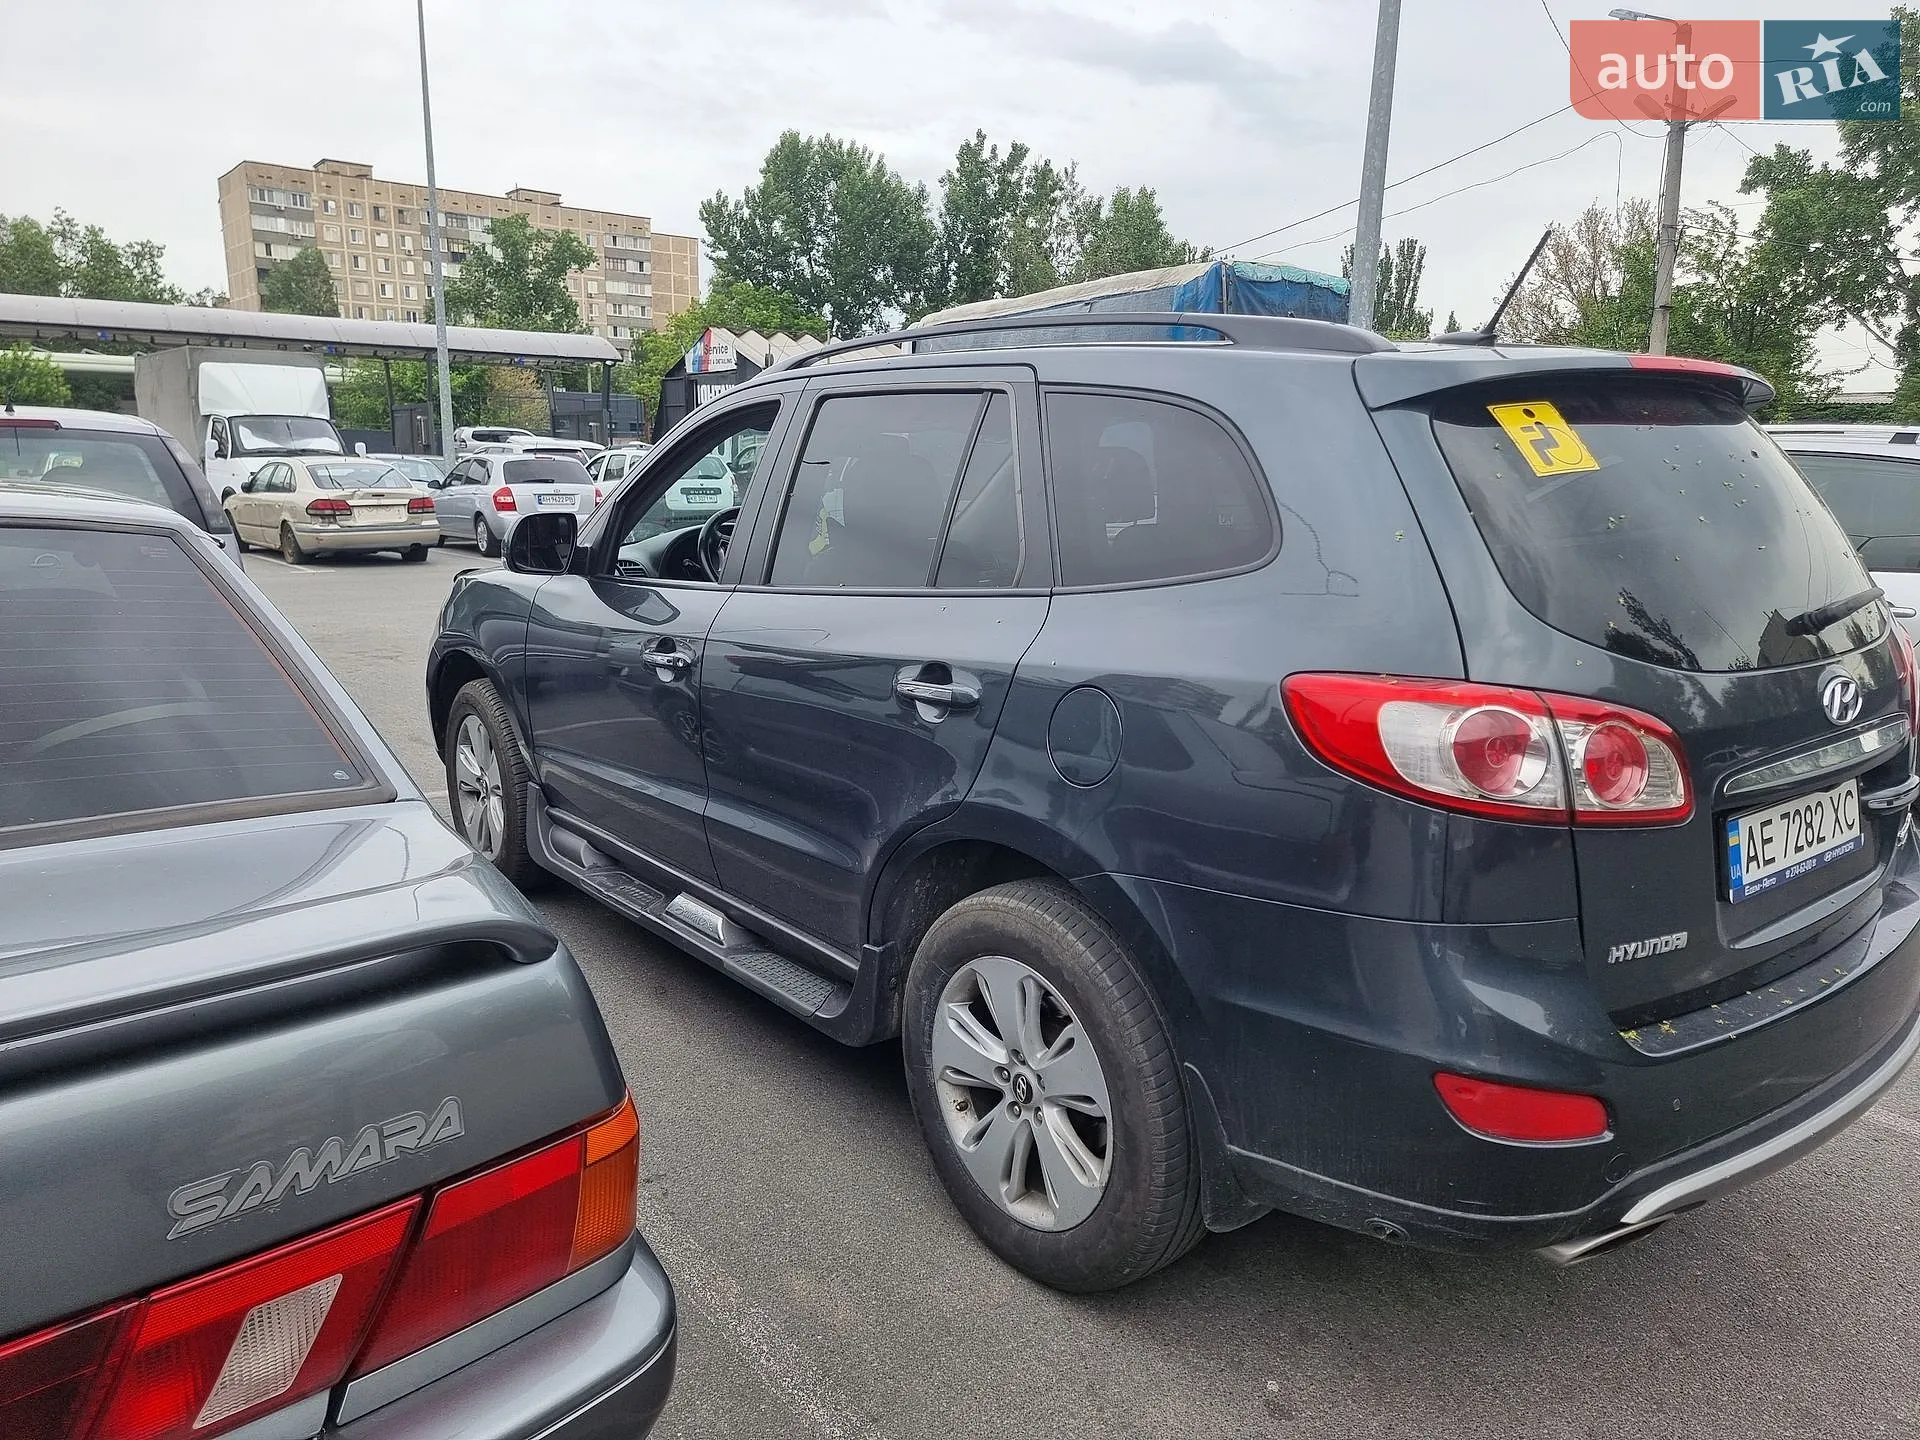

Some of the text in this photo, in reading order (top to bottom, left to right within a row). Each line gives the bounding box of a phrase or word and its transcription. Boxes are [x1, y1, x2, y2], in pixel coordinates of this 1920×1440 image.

[704, 343, 729, 355] Service
[1746, 819, 1776, 874] AE
[1780, 801, 1826, 859] 7282
[1829, 789, 1856, 839] XC
[1731, 865, 1743, 880] UA
[1607, 931, 1688, 964] HYUNDAI
[167, 1096, 465, 1240] SAMARA
